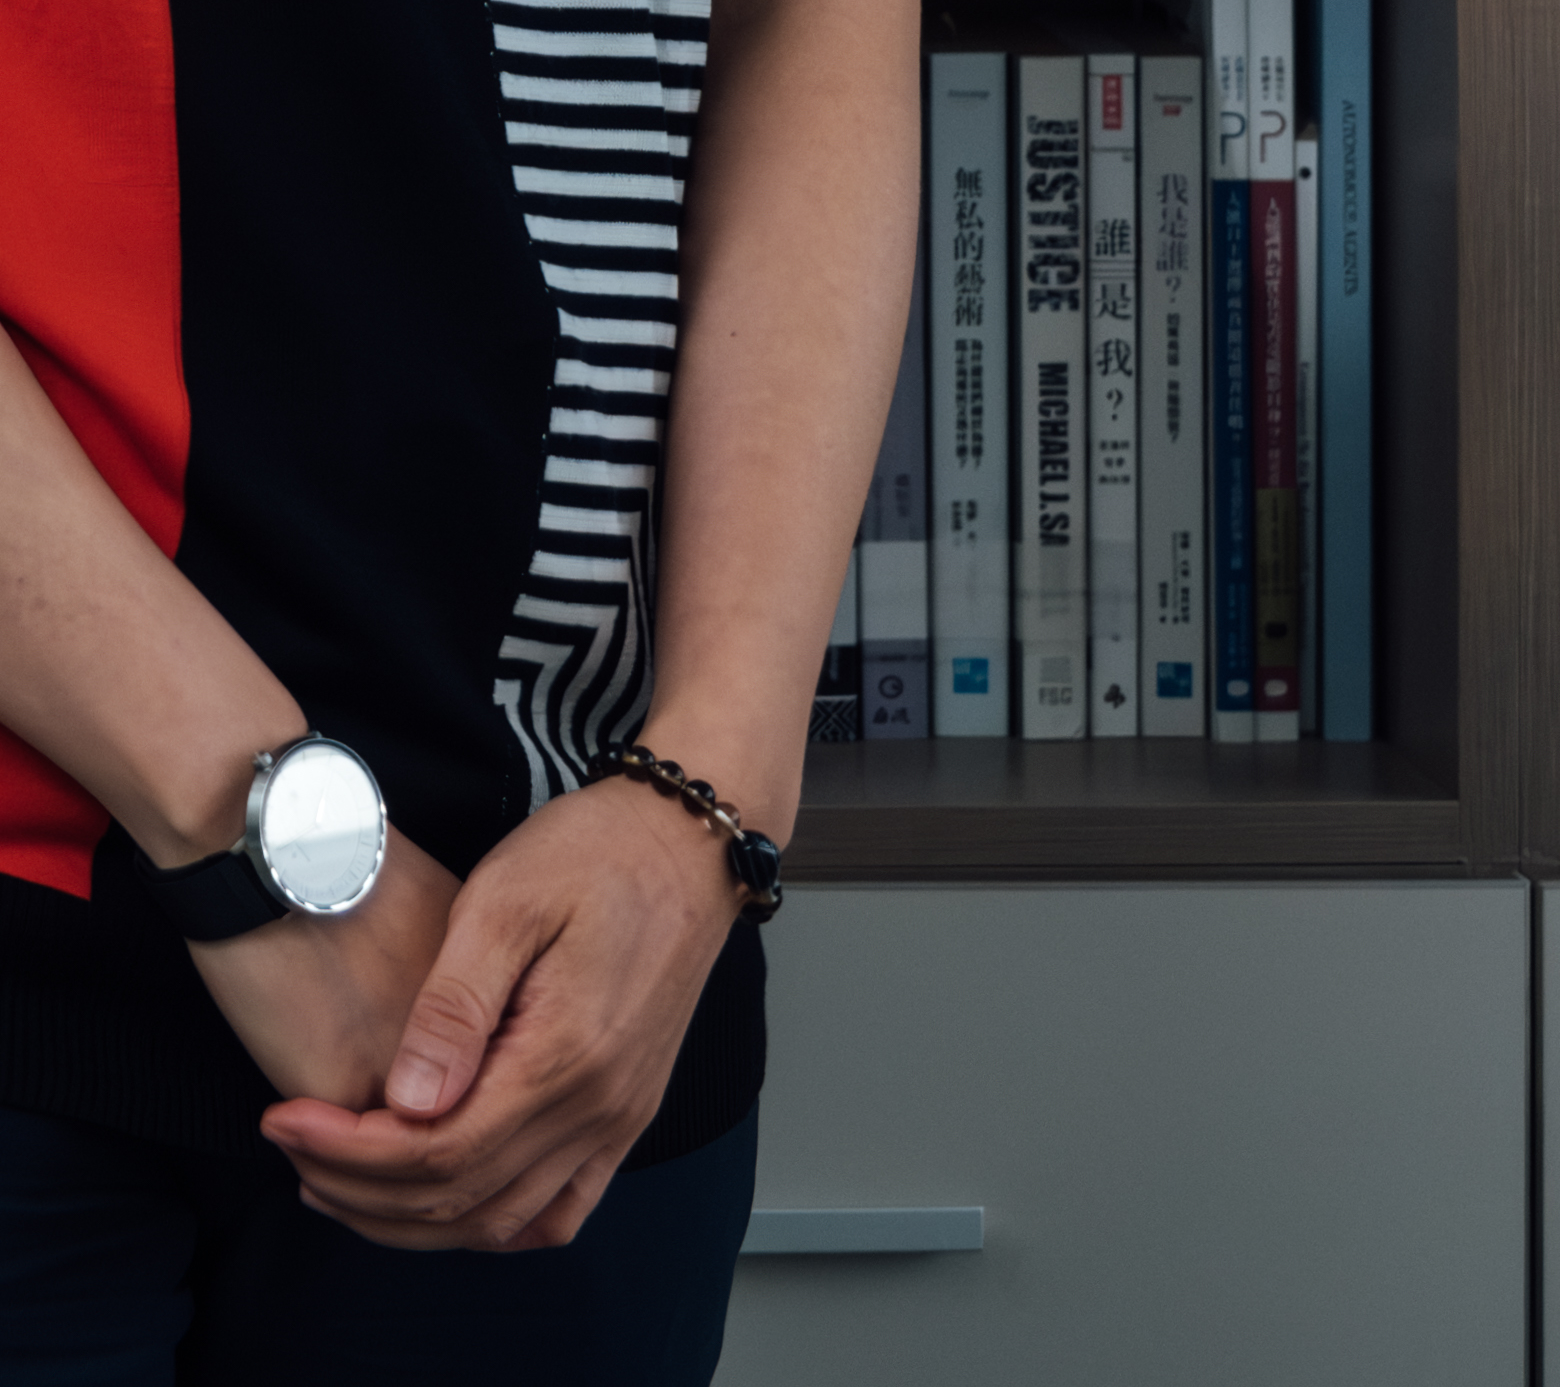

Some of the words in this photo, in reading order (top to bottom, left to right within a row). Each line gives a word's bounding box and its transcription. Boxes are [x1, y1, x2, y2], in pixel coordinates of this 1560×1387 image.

[953, 167, 984, 326] 無私的藝術
[1027, 115, 1080, 314] JUSTICE
[1156, 173, 1189, 304] 我是誰?
[1095, 218, 1134, 422] 誰是我?
[1039, 362, 1070, 486] MICHAEL
